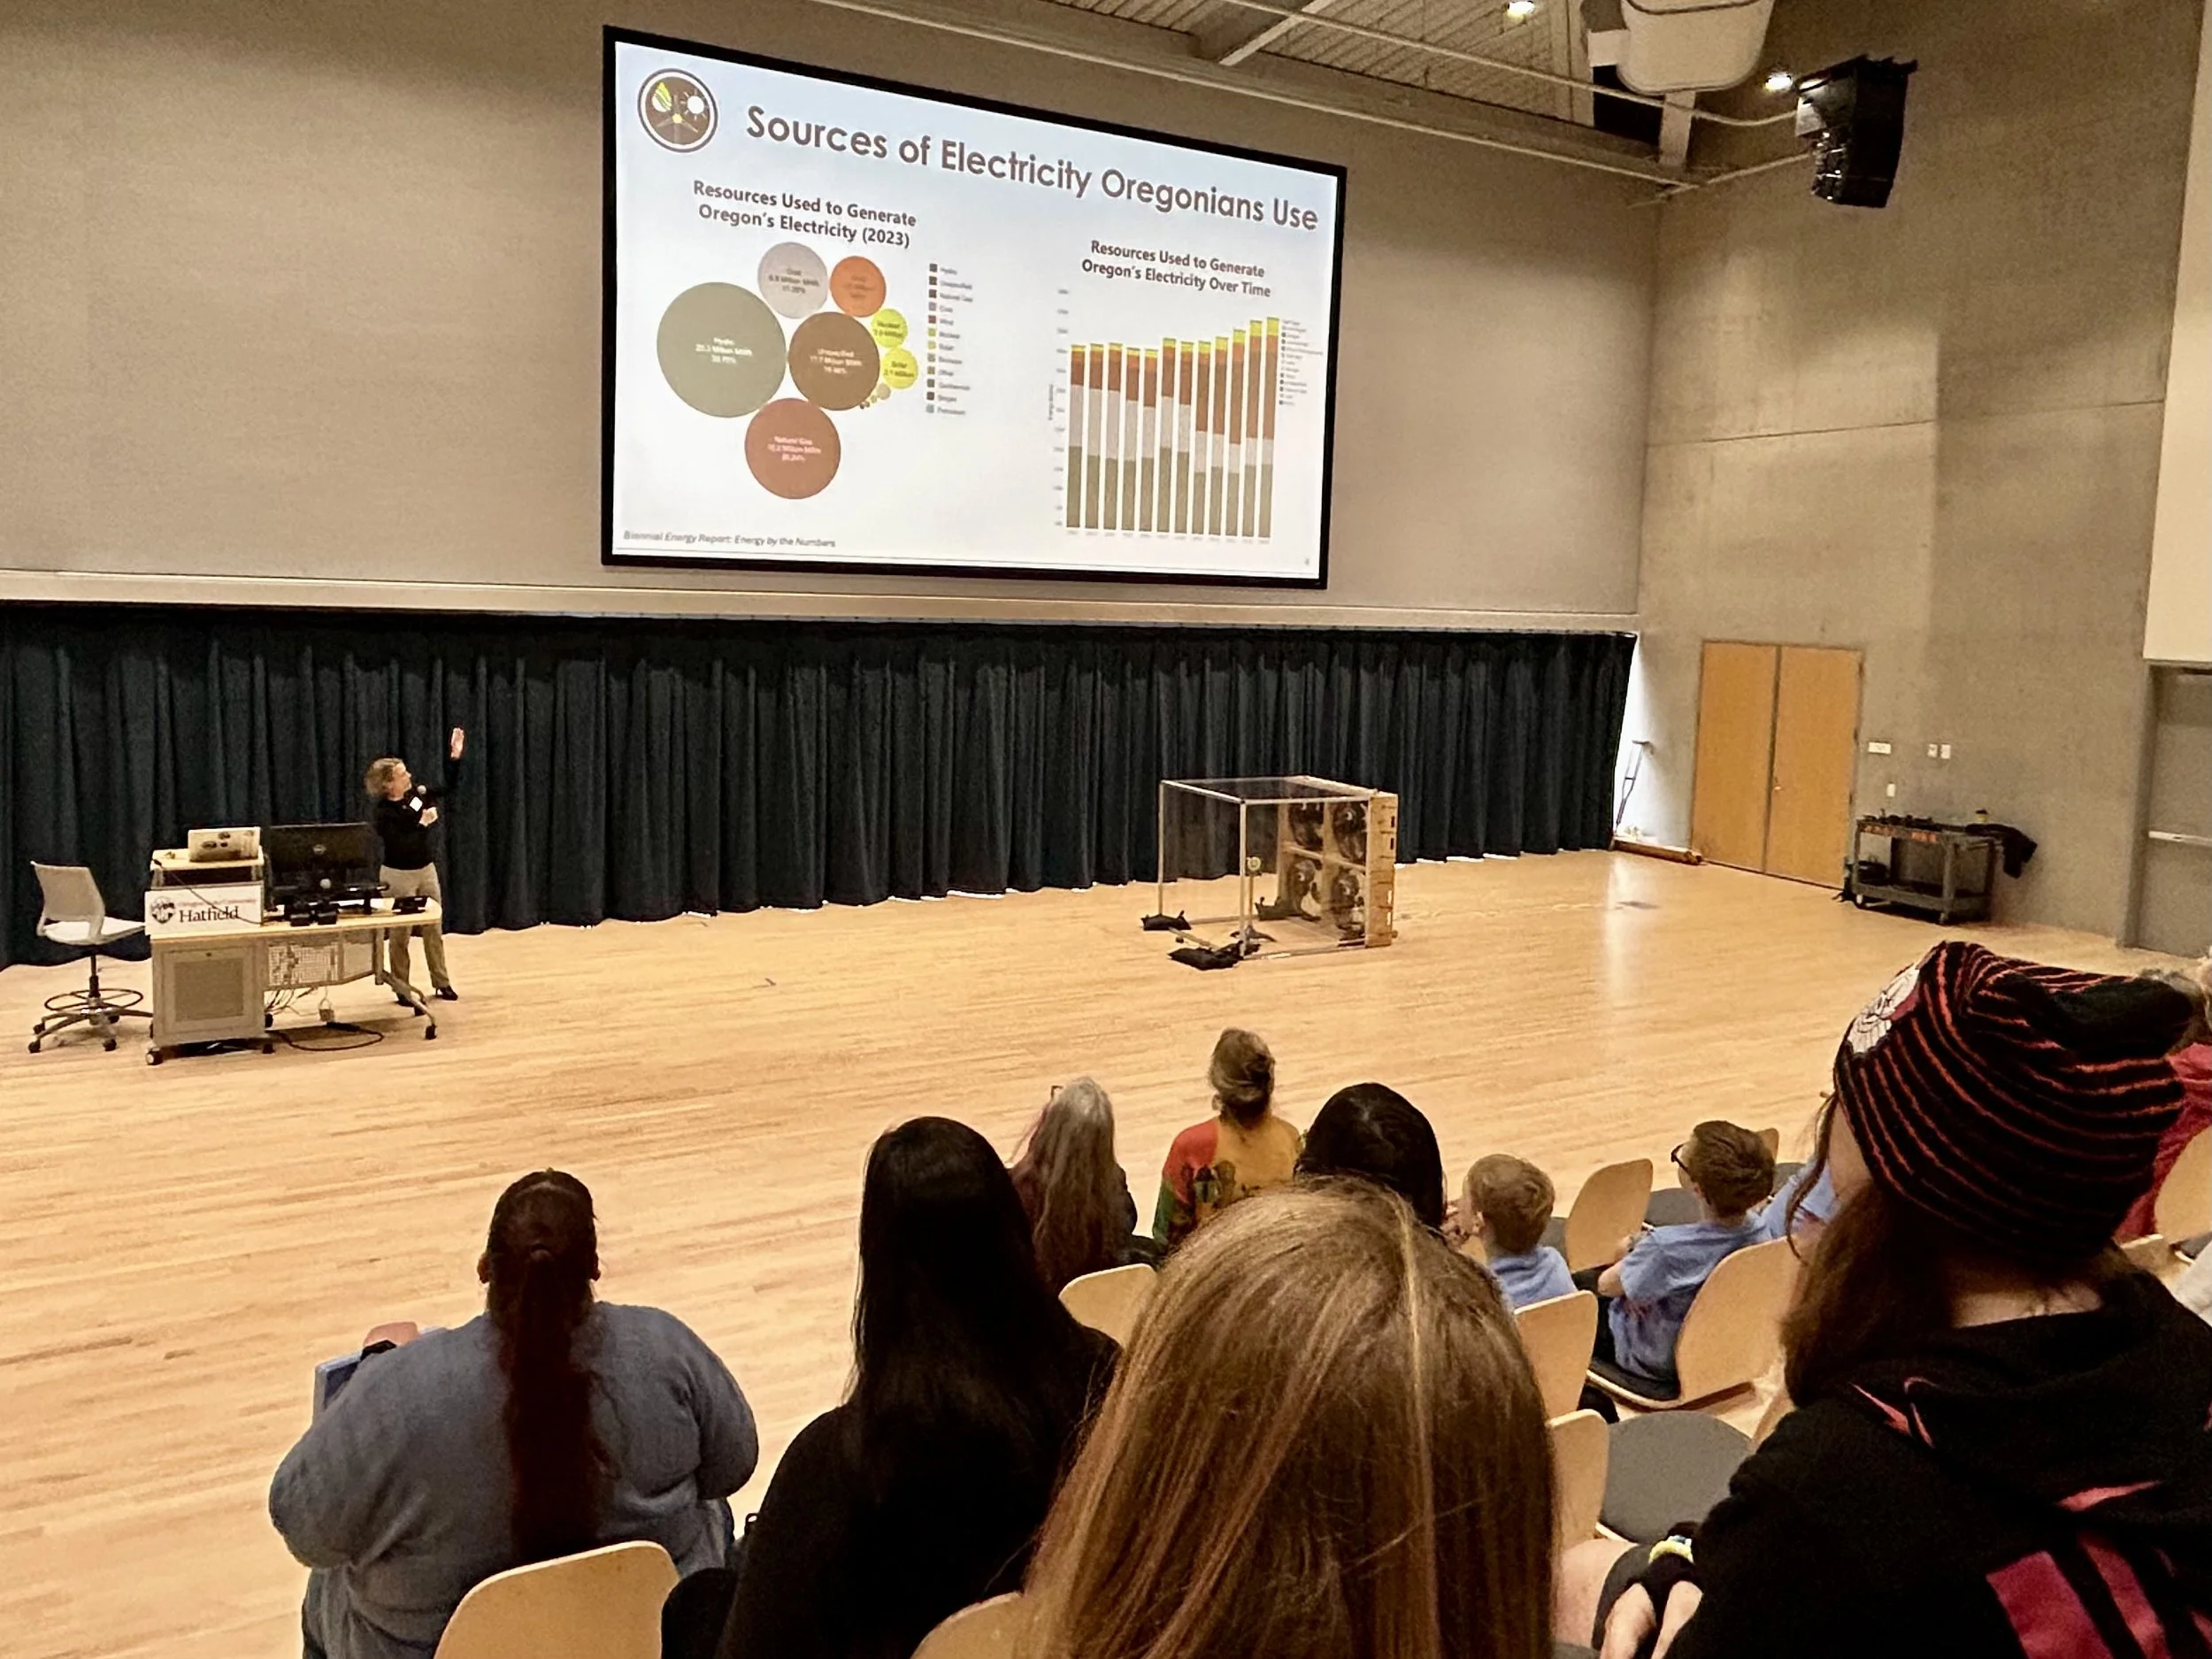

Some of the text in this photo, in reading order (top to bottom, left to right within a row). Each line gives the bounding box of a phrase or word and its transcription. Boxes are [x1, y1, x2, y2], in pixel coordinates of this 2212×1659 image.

[747, 105, 1319, 231] Sources of Electricity Oregonians Use
[694, 180, 917, 227] Resources Used to Generate
[699, 204, 910, 250] Oregon's Electricity (2023)
[1082, 259, 1271, 297] Oregon's Electricity Over Time
[1091, 240, 1265, 279] Resources Used to Generate
[623, 531, 664, 541] Biennial
[664, 533, 696, 544] Energy
[734, 535, 765, 547] Energy
[766, 536, 778, 547] by
[780, 536, 794, 546] the
[795, 537, 836, 548] Numbers
[179, 905, 240, 923] Hatfield
